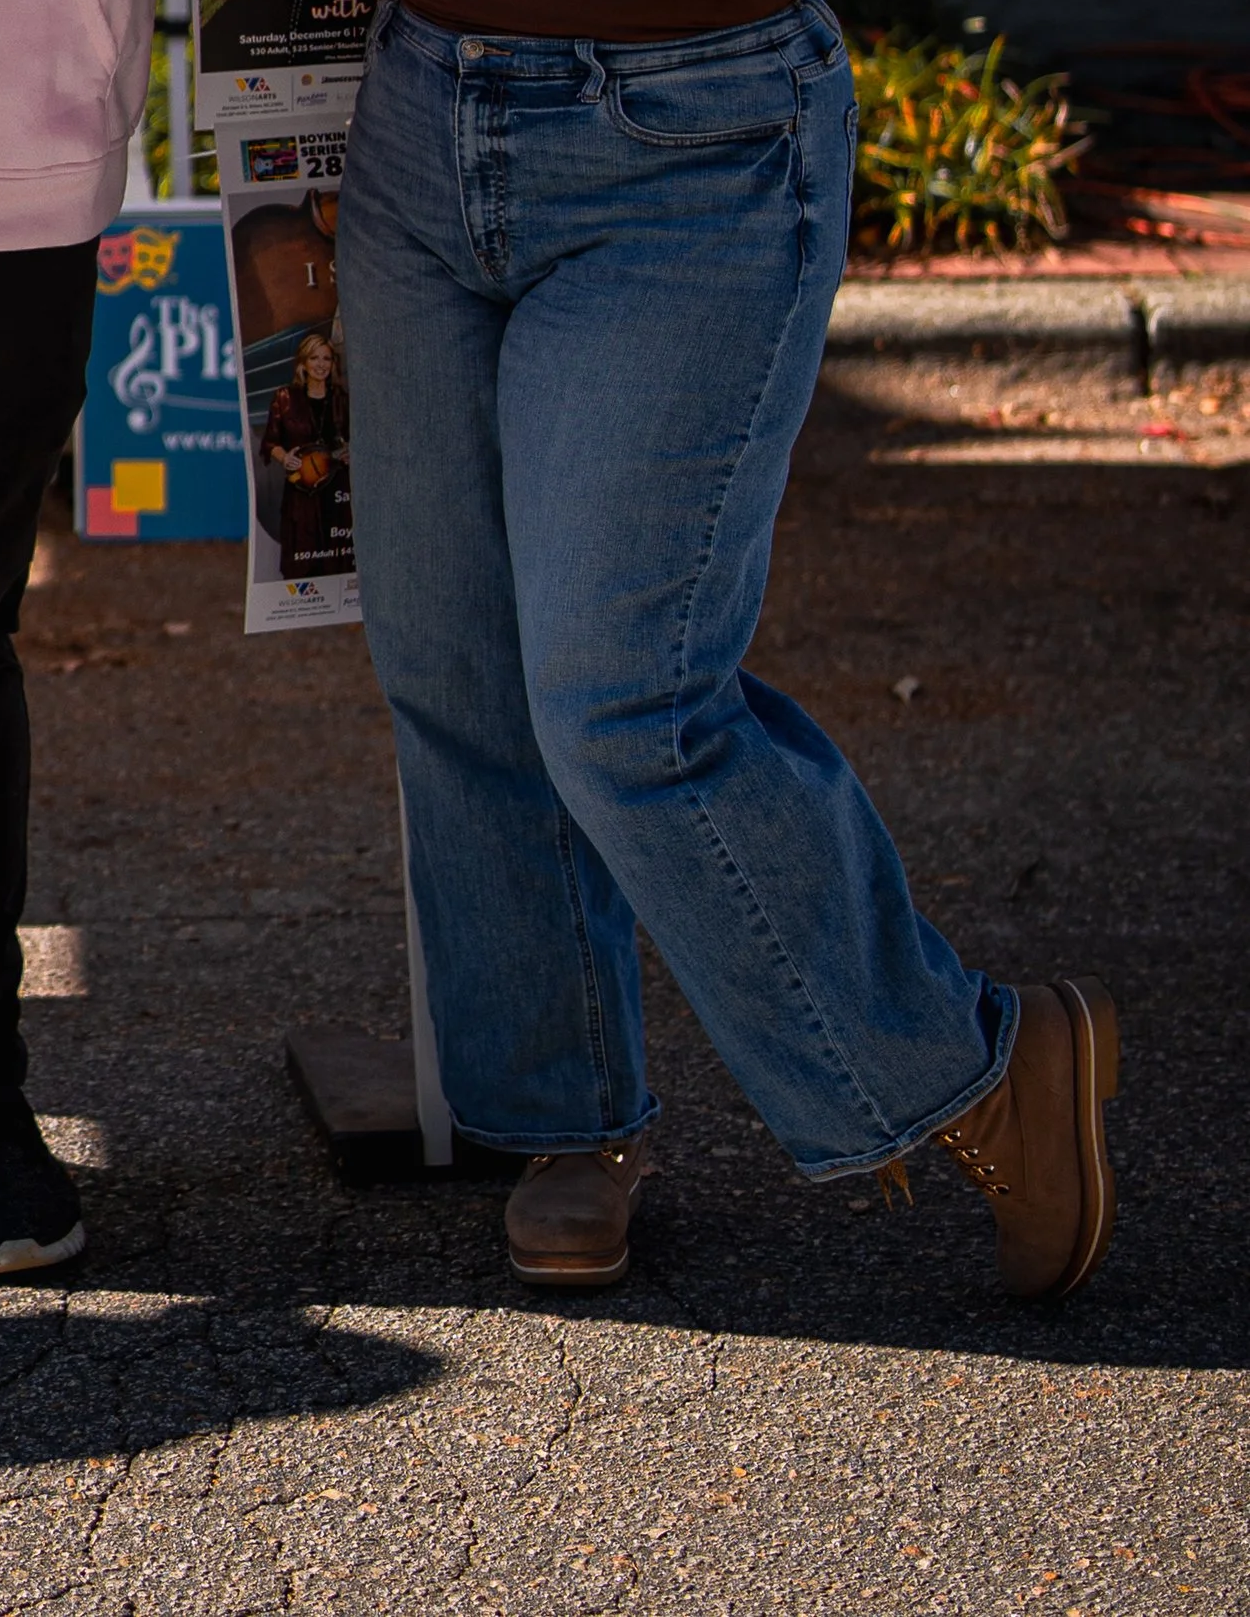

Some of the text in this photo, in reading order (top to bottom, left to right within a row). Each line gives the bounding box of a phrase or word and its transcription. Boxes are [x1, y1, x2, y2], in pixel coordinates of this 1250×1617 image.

[239, 31, 287, 48] Saturday,
[289, 28, 342, 42] December
[249, 47, 266, 59] $30
[308, 40, 366, 54] Senior/Studen
[299, 131, 346, 144] BOYKIN
[301, 143, 347, 157] SERIES
[306, 156, 343, 178] 28
[151, 294, 221, 330] The
[293, 550, 312, 562] $50
[312, 549, 334, 560] Adult
